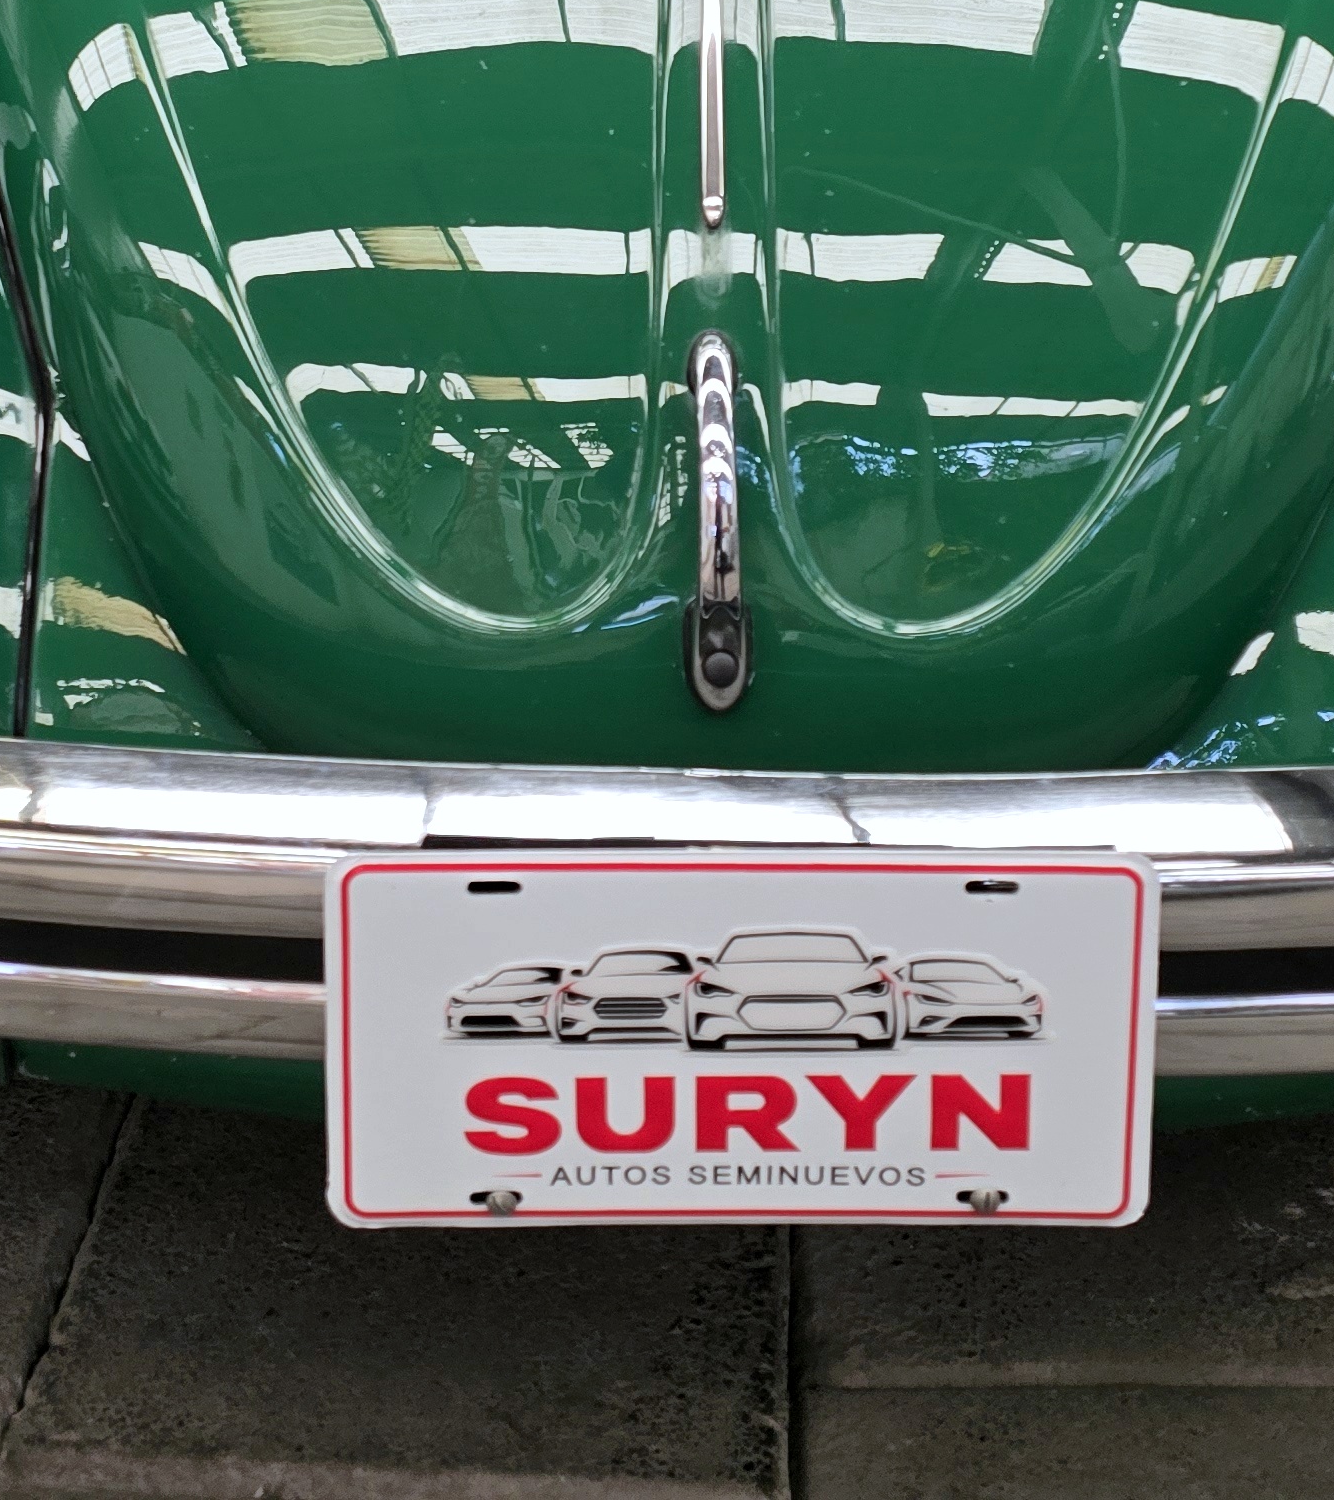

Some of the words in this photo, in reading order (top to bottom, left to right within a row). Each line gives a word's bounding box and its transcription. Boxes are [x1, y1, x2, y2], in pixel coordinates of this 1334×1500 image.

[463, 1073, 1032, 1157] SURYN
[549, 1165, 672, 1188] AUTOS
[687, 1165, 927, 1188] SEMINUEVOS
